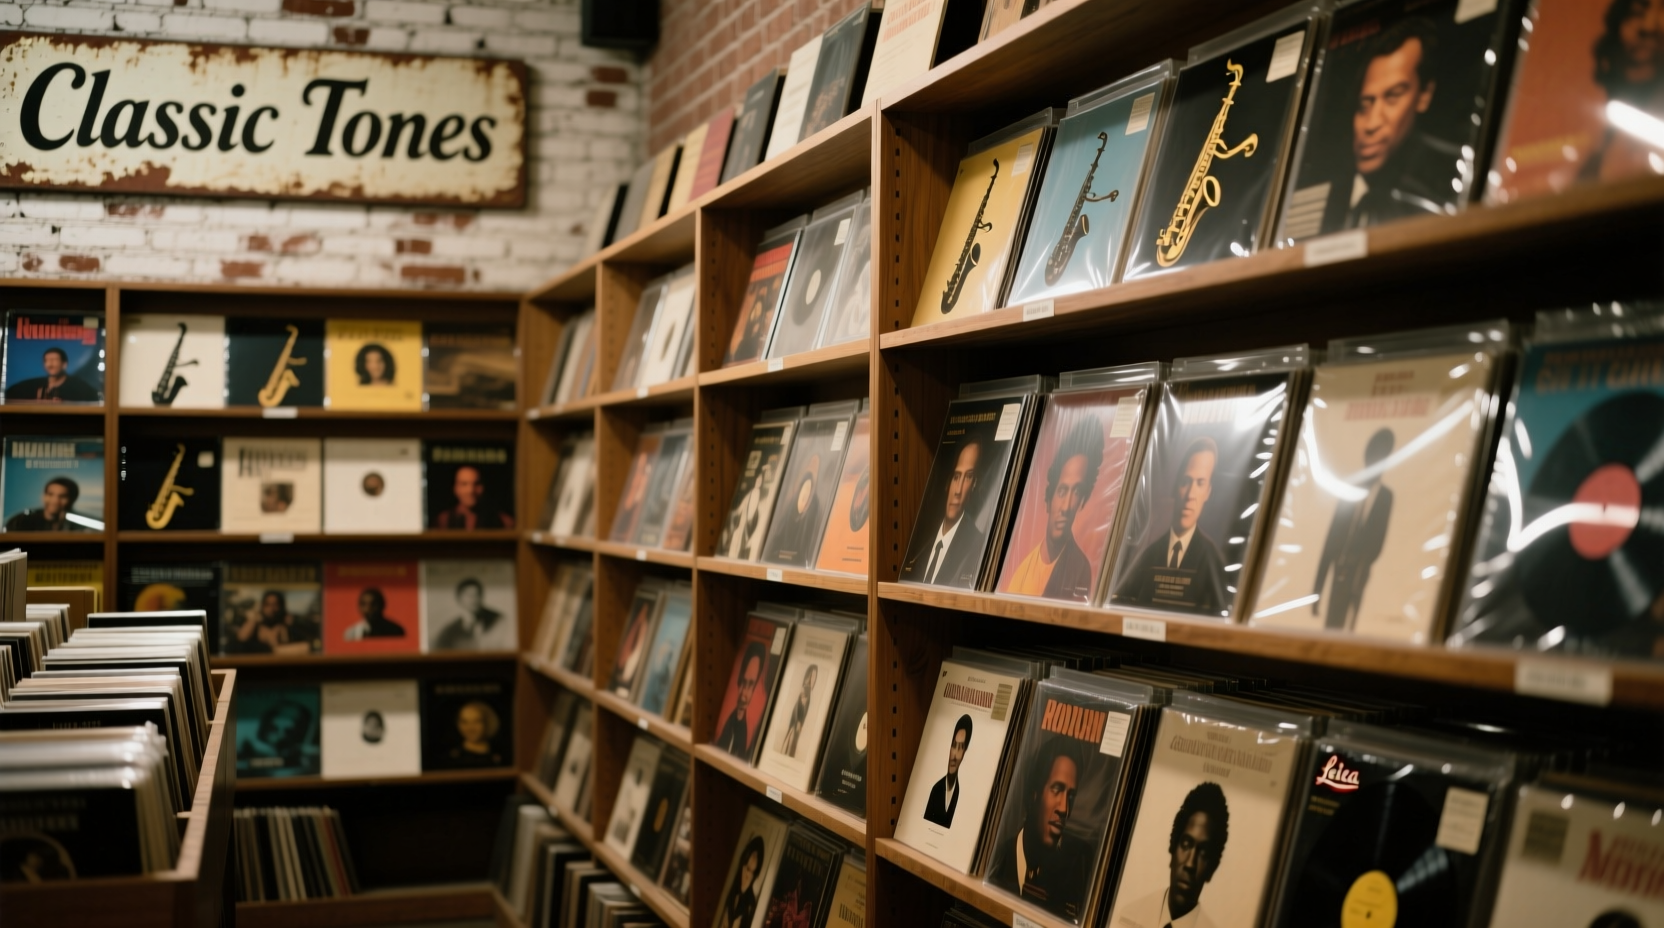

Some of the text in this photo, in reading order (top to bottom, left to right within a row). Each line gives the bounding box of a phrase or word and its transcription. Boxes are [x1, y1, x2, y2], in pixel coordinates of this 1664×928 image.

[20, 62, 498, 163] Classic Tones
[1315, 755, 1359, 789] Leica
